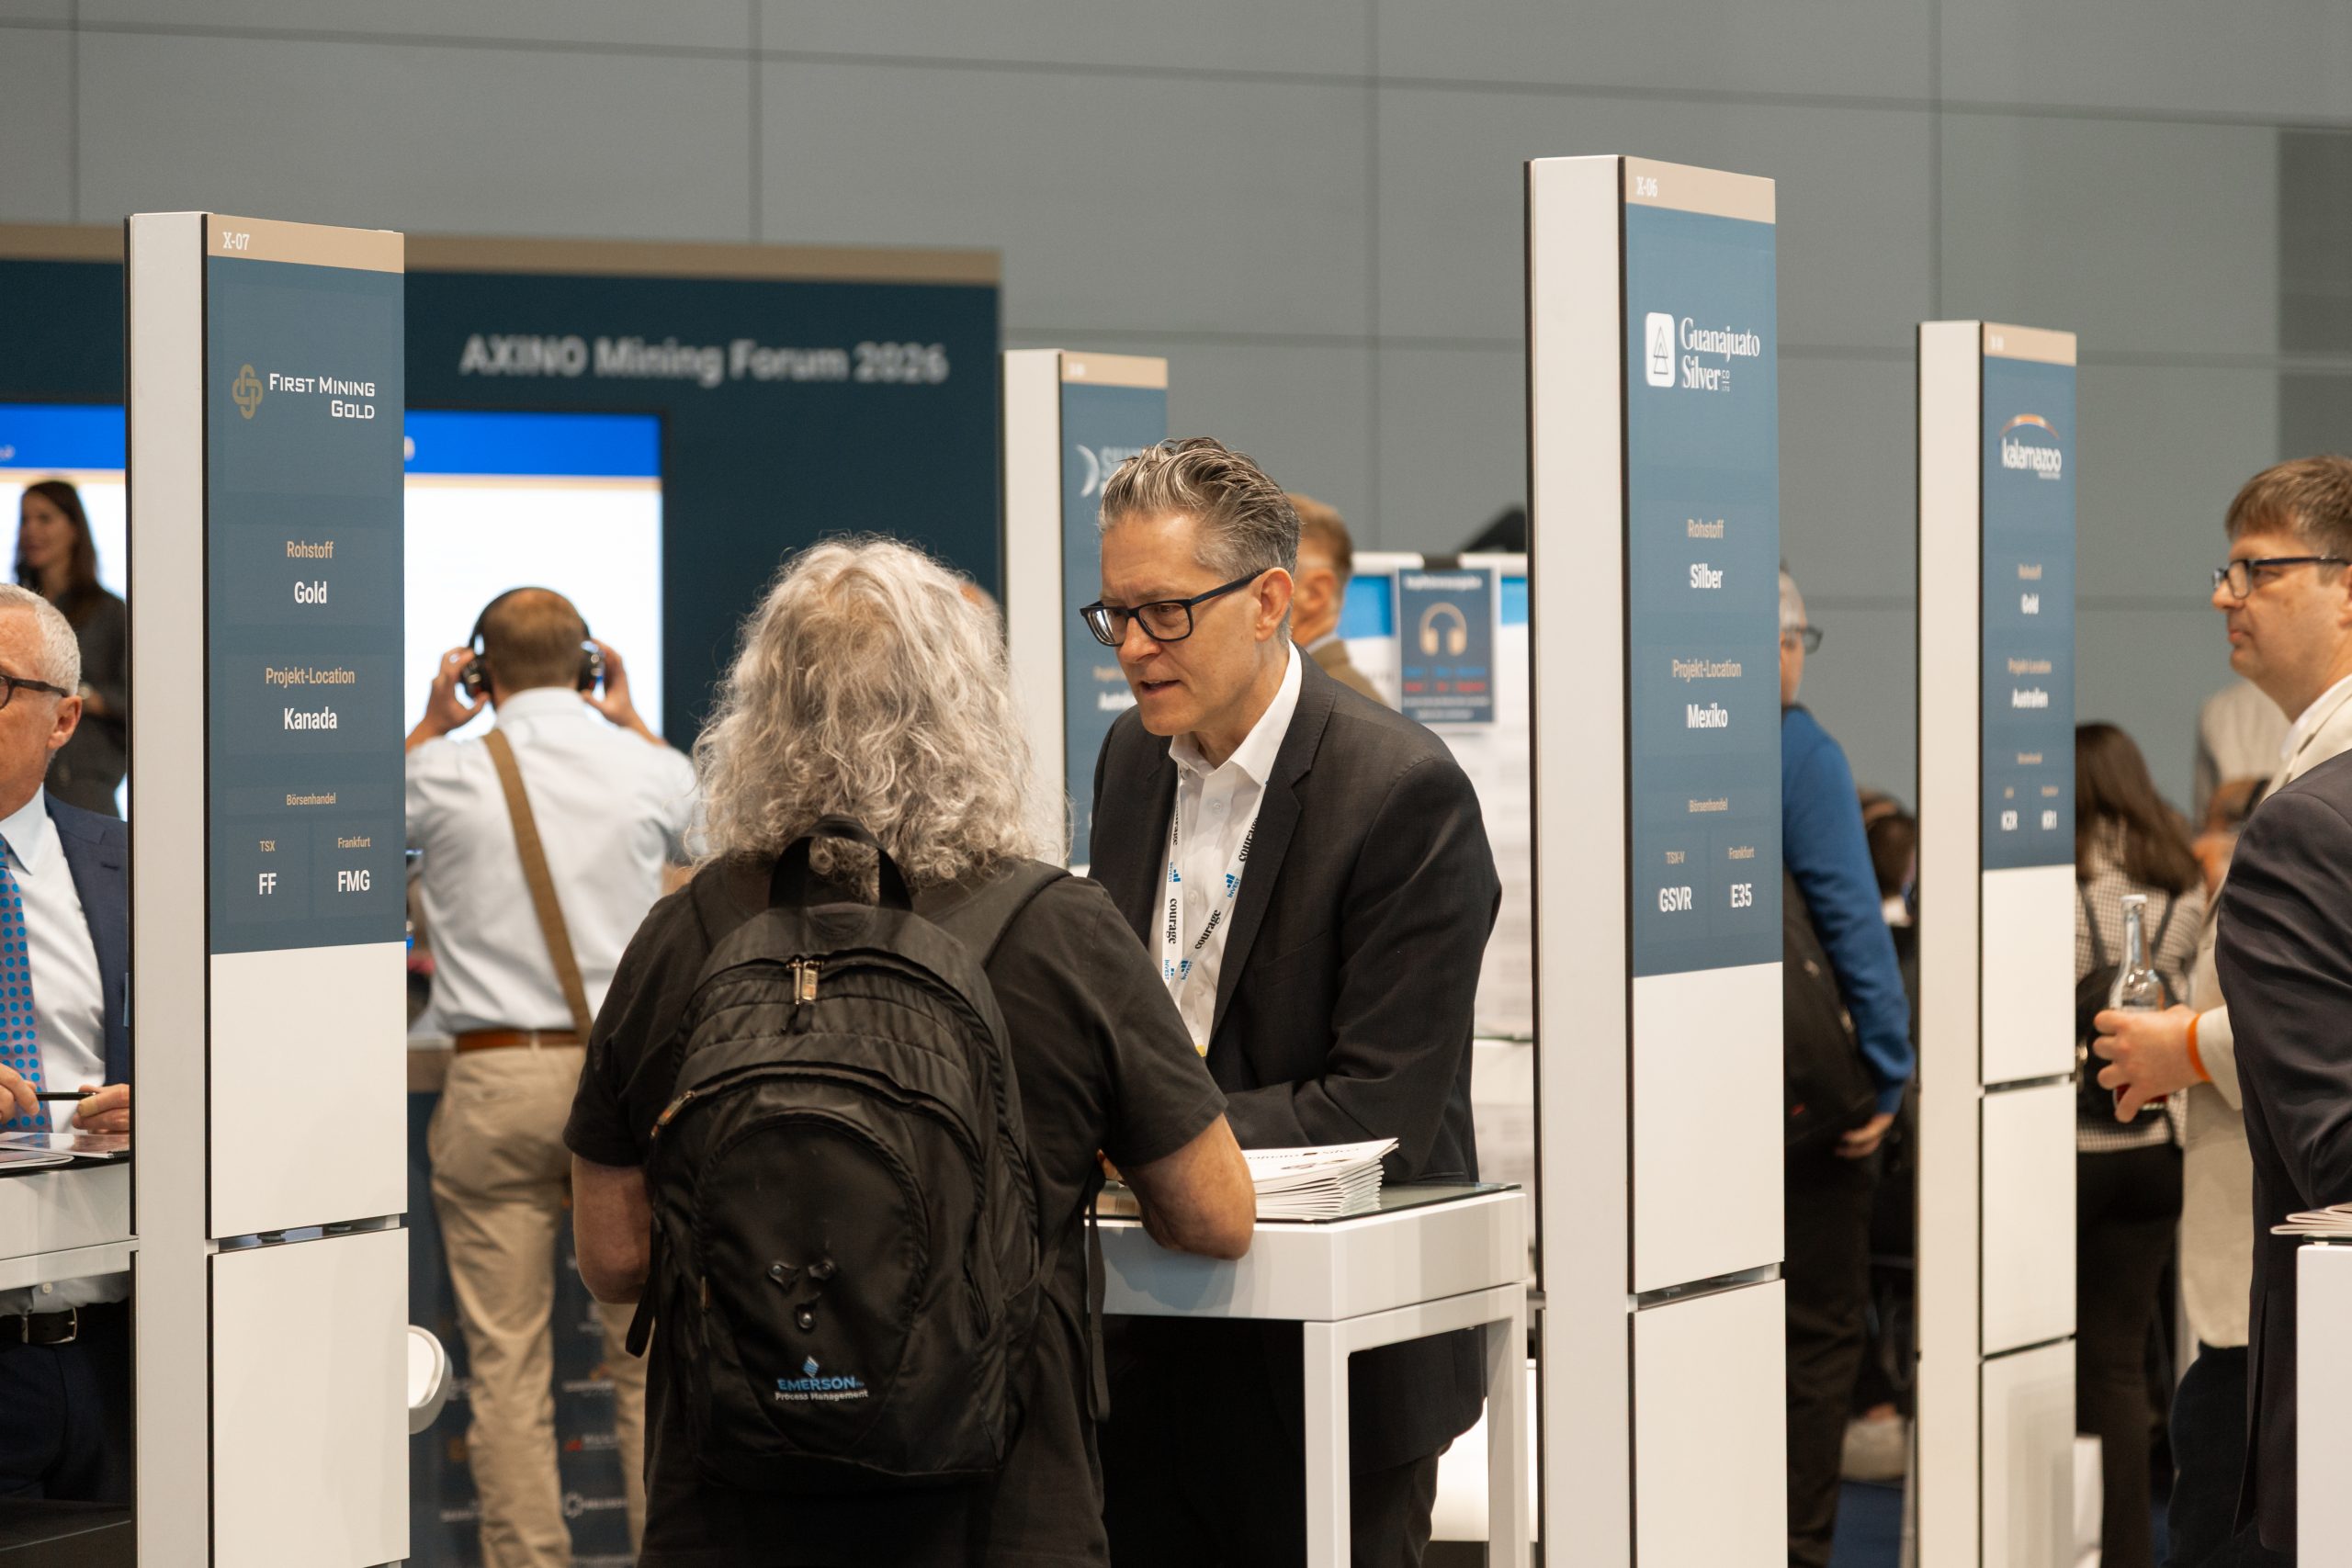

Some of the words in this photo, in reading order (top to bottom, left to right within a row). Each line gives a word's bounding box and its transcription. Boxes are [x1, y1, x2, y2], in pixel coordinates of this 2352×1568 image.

[222, 231, 250, 251] X-07
[1680, 317, 1760, 363] Guanajuato
[461, 334, 588, 378] AXINO
[594, 336, 725, 389] Mining
[729, 338, 850, 381] Forum
[1682, 355, 1721, 390] Silver
[1687, 519, 1724, 539] Rohstoff
[287, 540, 334, 558] Rohstoff
[1690, 562, 1723, 589] Silber
[294, 581, 327, 604] Gold
[266, 667, 356, 689] Projekt-Location
[1672, 659, 1742, 682] Projekt-Location
[284, 706, 337, 730] Kanada
[1686, 703, 1728, 728] Mexiko
[287, 793, 336, 806] Börsenhandel
[260, 840, 276, 852] TSX
[337, 836, 371, 849] Frankfurt
[258, 873, 277, 895] FF
[337, 869, 370, 892] FMG
[1659, 886, 1692, 912] GSVR
[1731, 883, 1752, 908] E35
[1166, 897, 1178, 945] courage
[1195, 909, 1221, 950] courage
[777, 1376, 856, 1391] EMERSON
[775, 1392, 808, 1401] Process
[810, 1389, 869, 1402] Management
